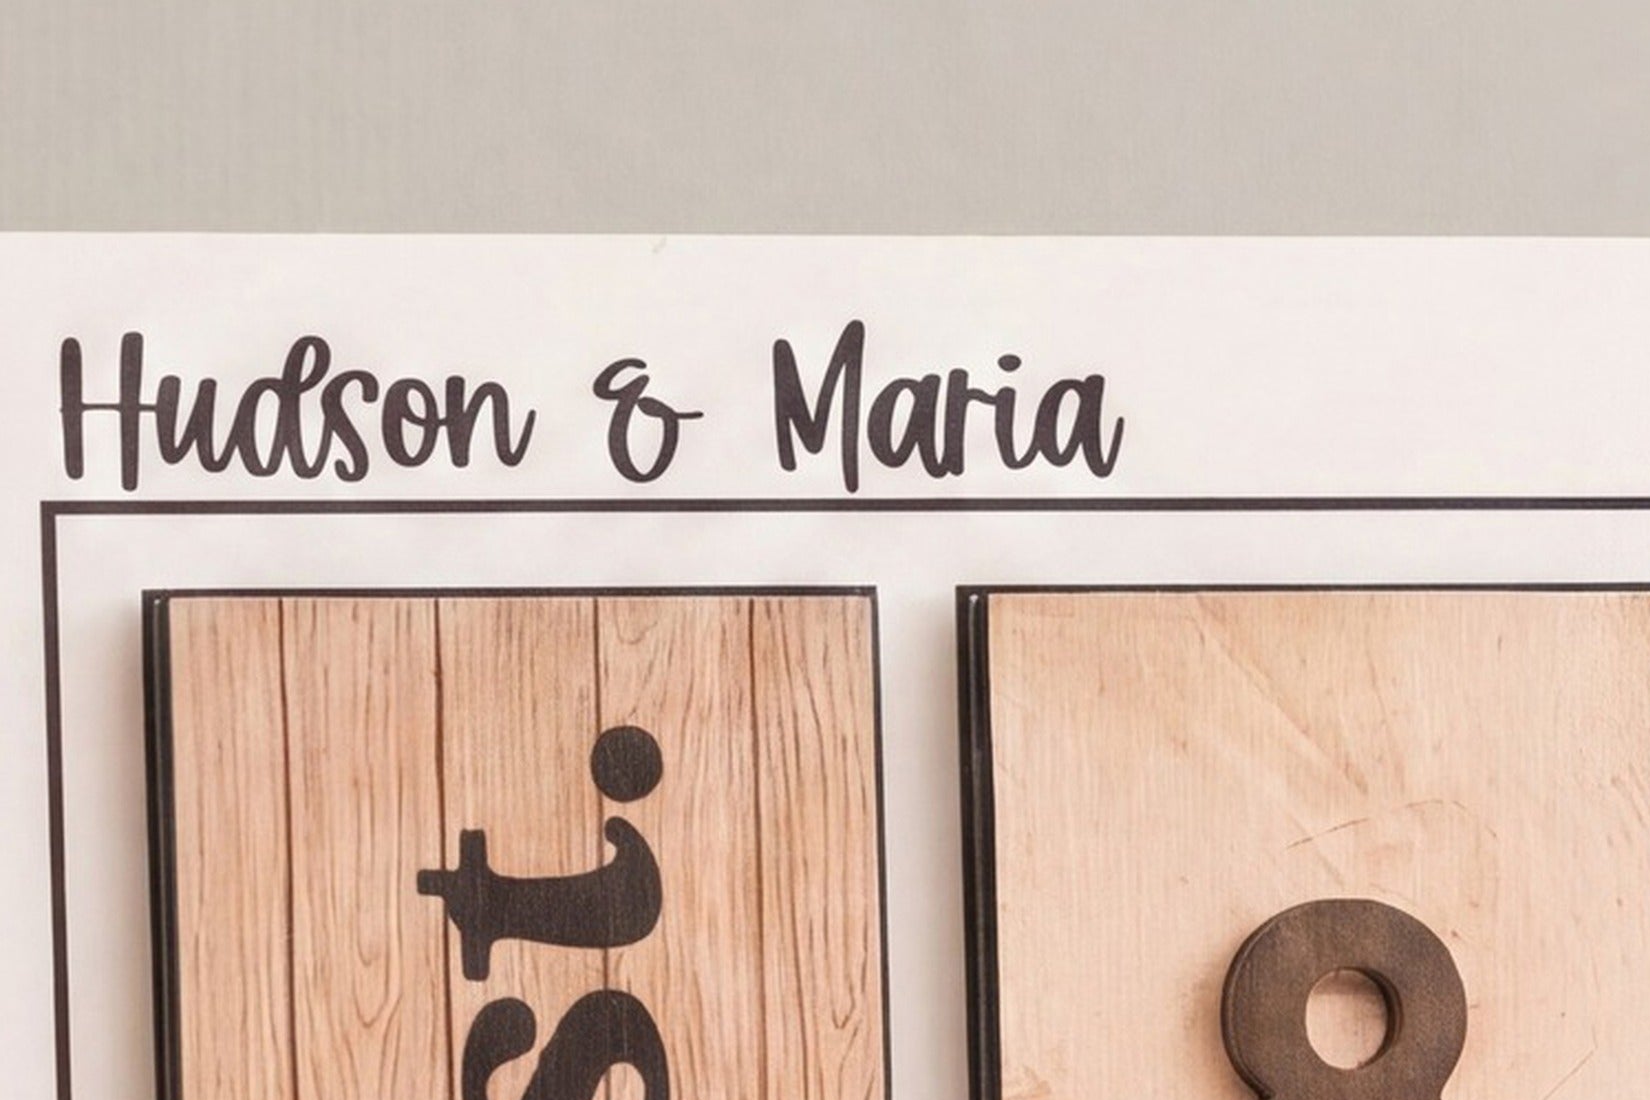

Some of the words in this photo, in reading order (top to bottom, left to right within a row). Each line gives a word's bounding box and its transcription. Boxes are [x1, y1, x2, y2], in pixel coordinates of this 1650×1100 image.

[60, 332, 536, 491] Hudson
[593, 358, 704, 483] &
[772, 319, 1124, 494] Maria
